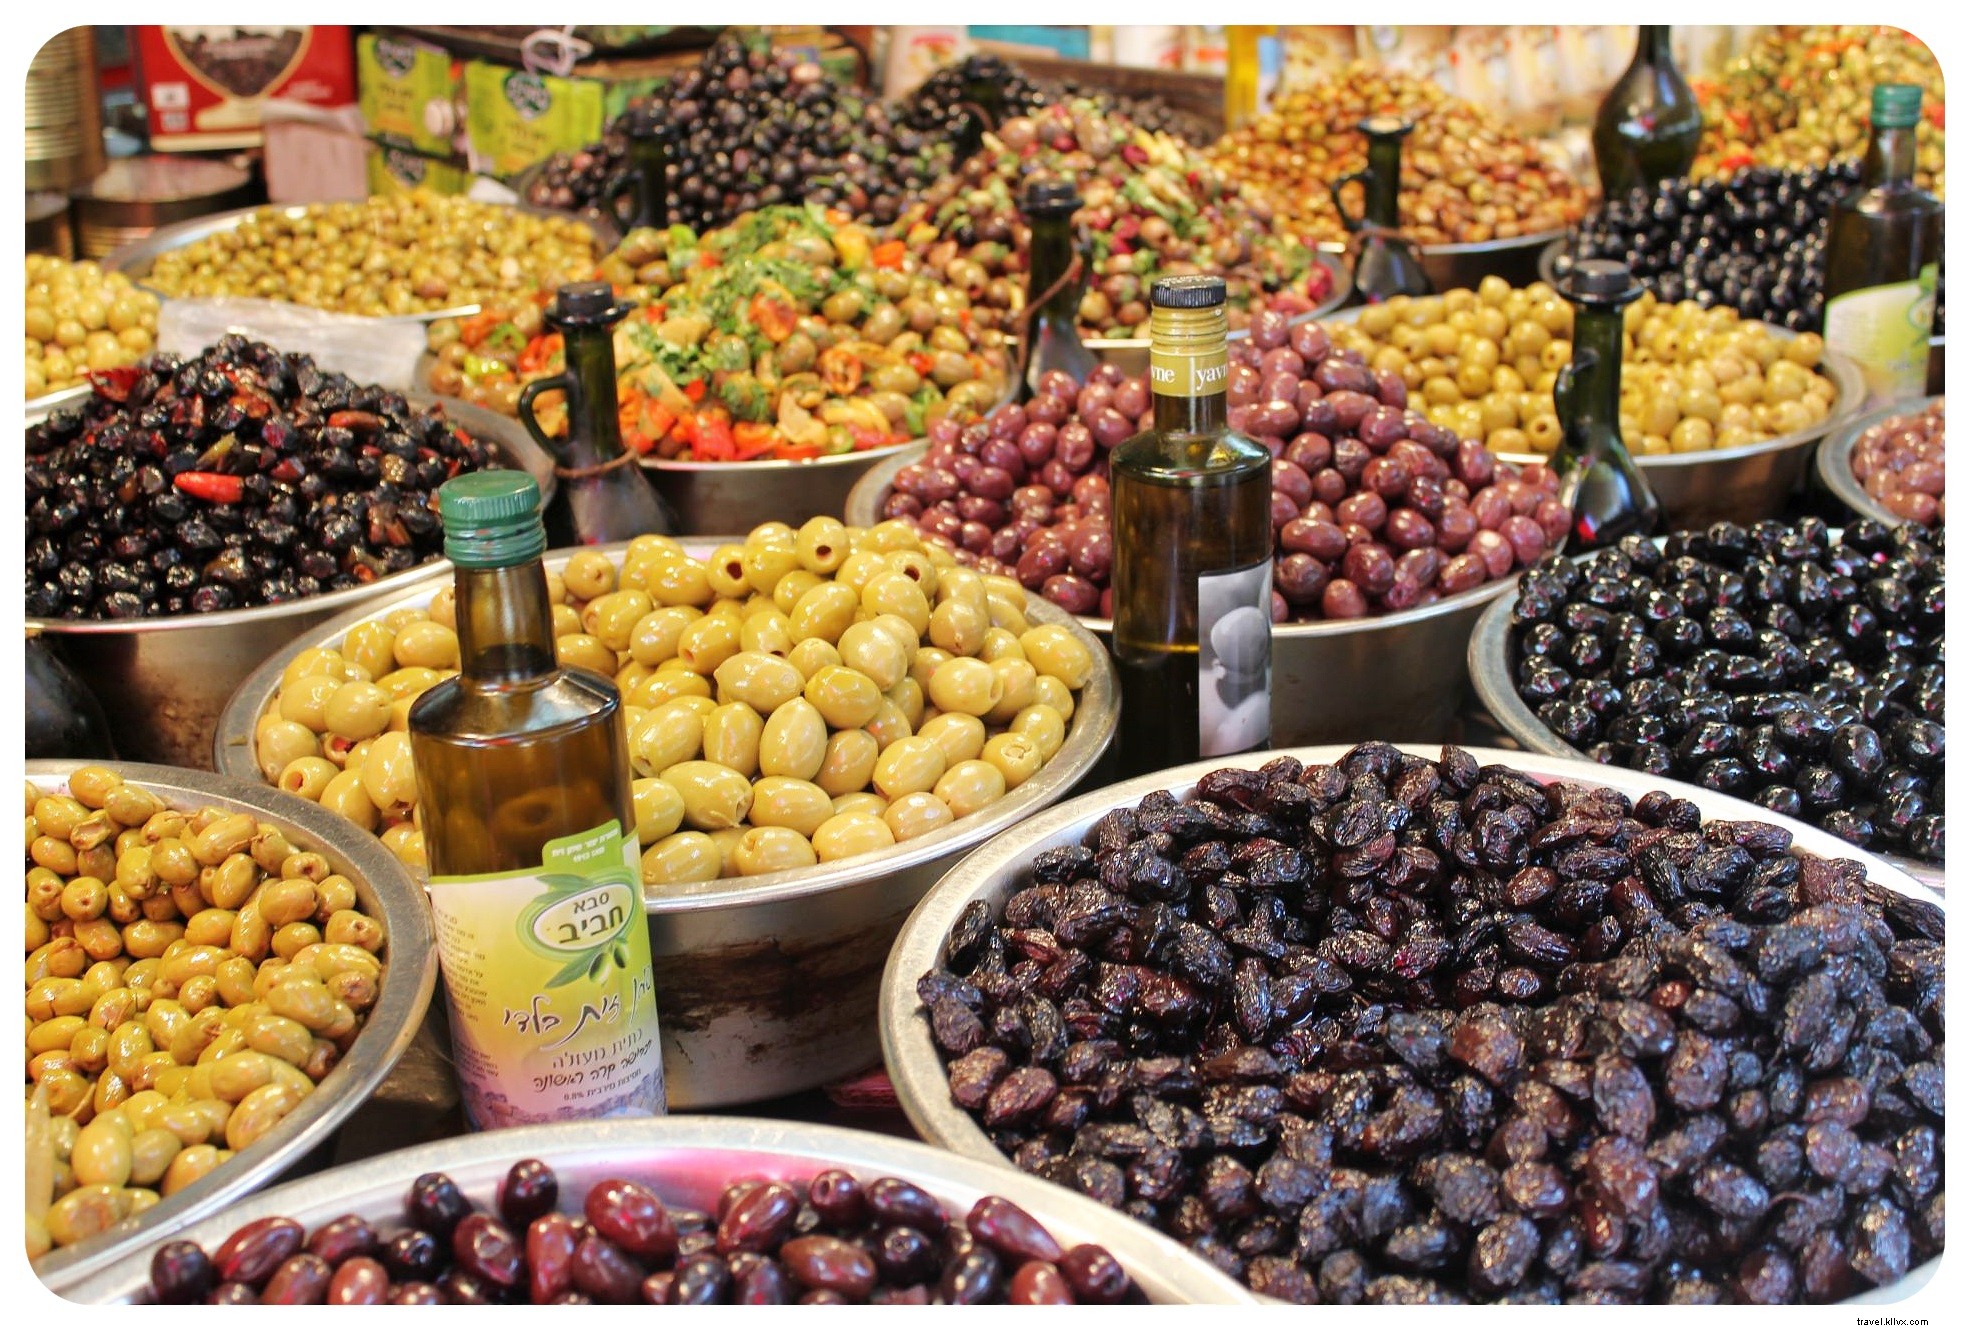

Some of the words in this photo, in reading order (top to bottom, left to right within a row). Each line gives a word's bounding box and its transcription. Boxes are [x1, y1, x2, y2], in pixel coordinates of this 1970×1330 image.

[573, 892, 609, 914] סבא
[558, 906, 623, 944] חביב
[503, 993, 561, 1034] בלדי
[532, 1070, 583, 1093] ראשונה
[589, 1063, 616, 1081] קרה
